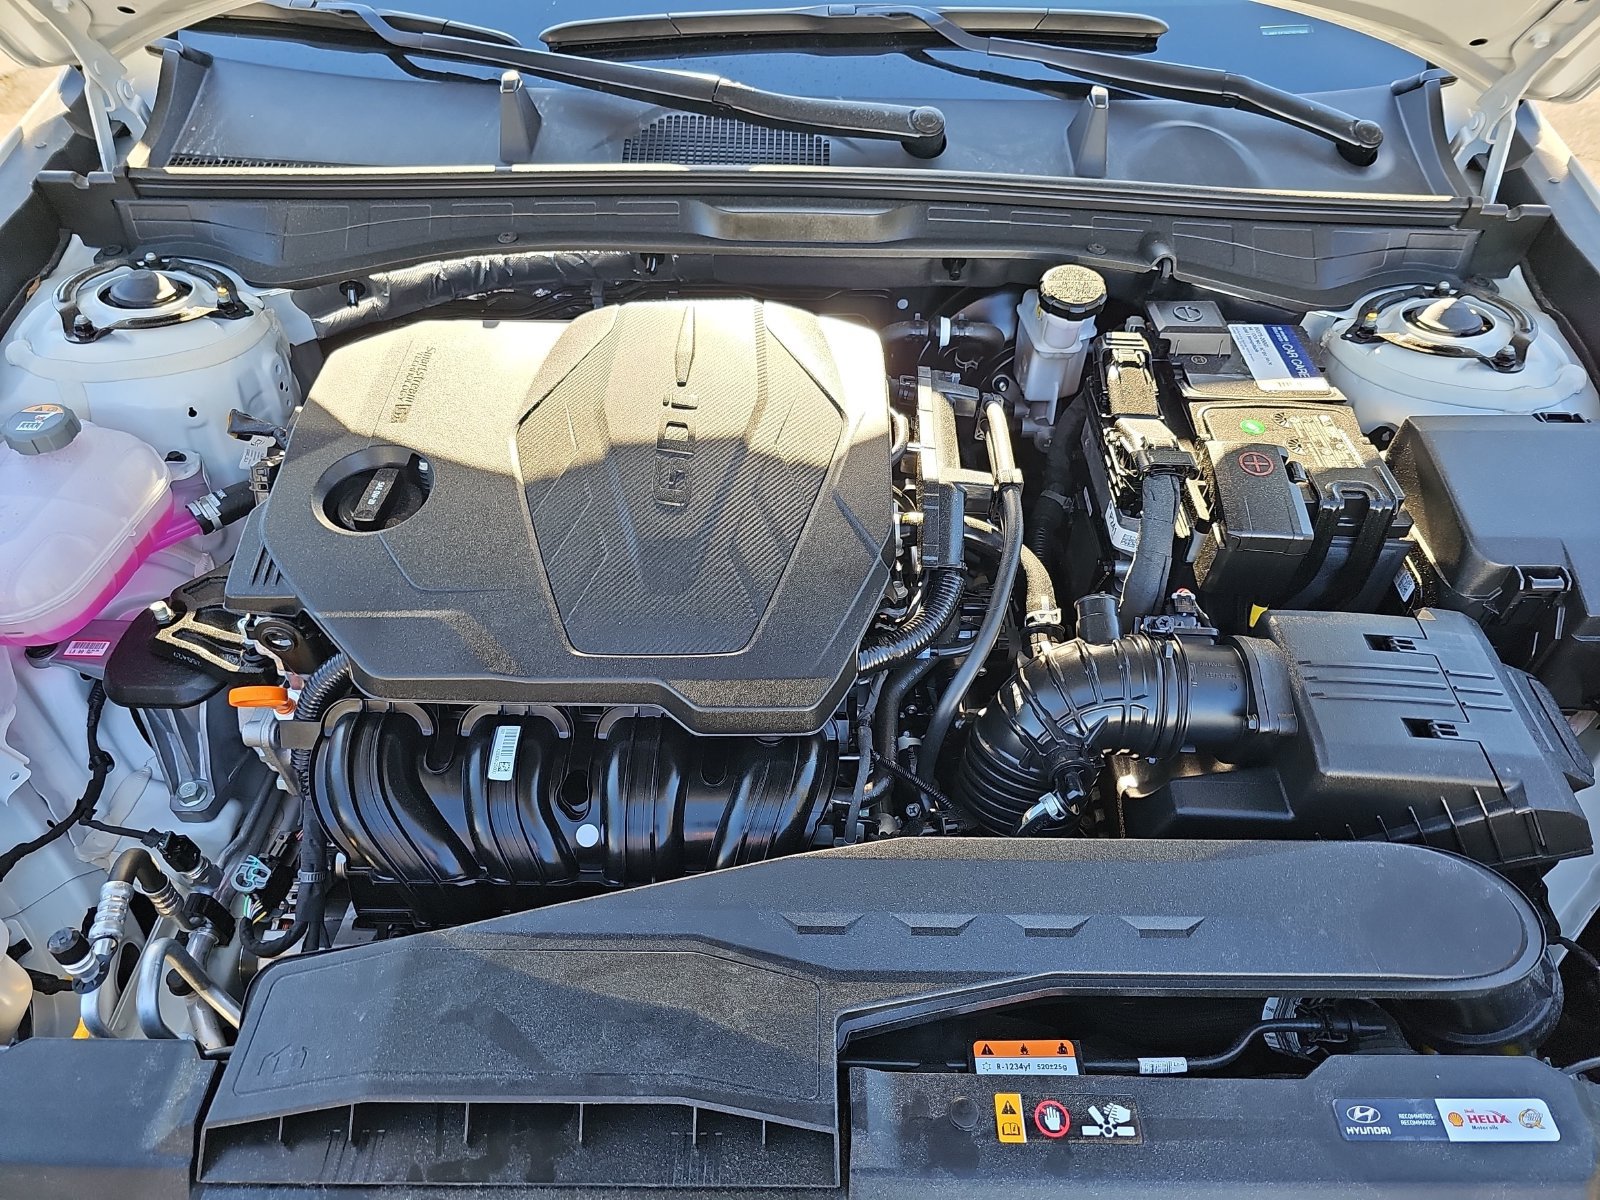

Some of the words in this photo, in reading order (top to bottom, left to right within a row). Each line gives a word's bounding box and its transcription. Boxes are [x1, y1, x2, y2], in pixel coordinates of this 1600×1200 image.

[1282, 343, 1299, 358] CAR
[1291, 359, 1310, 378] CARE
[996, 1062, 1031, 1071] R-1234yf
[1036, 1063, 1068, 1071] 520±25g
[1467, 1114, 1511, 1123] HELIX
[1346, 1126, 1392, 1135] HYUNDAI
